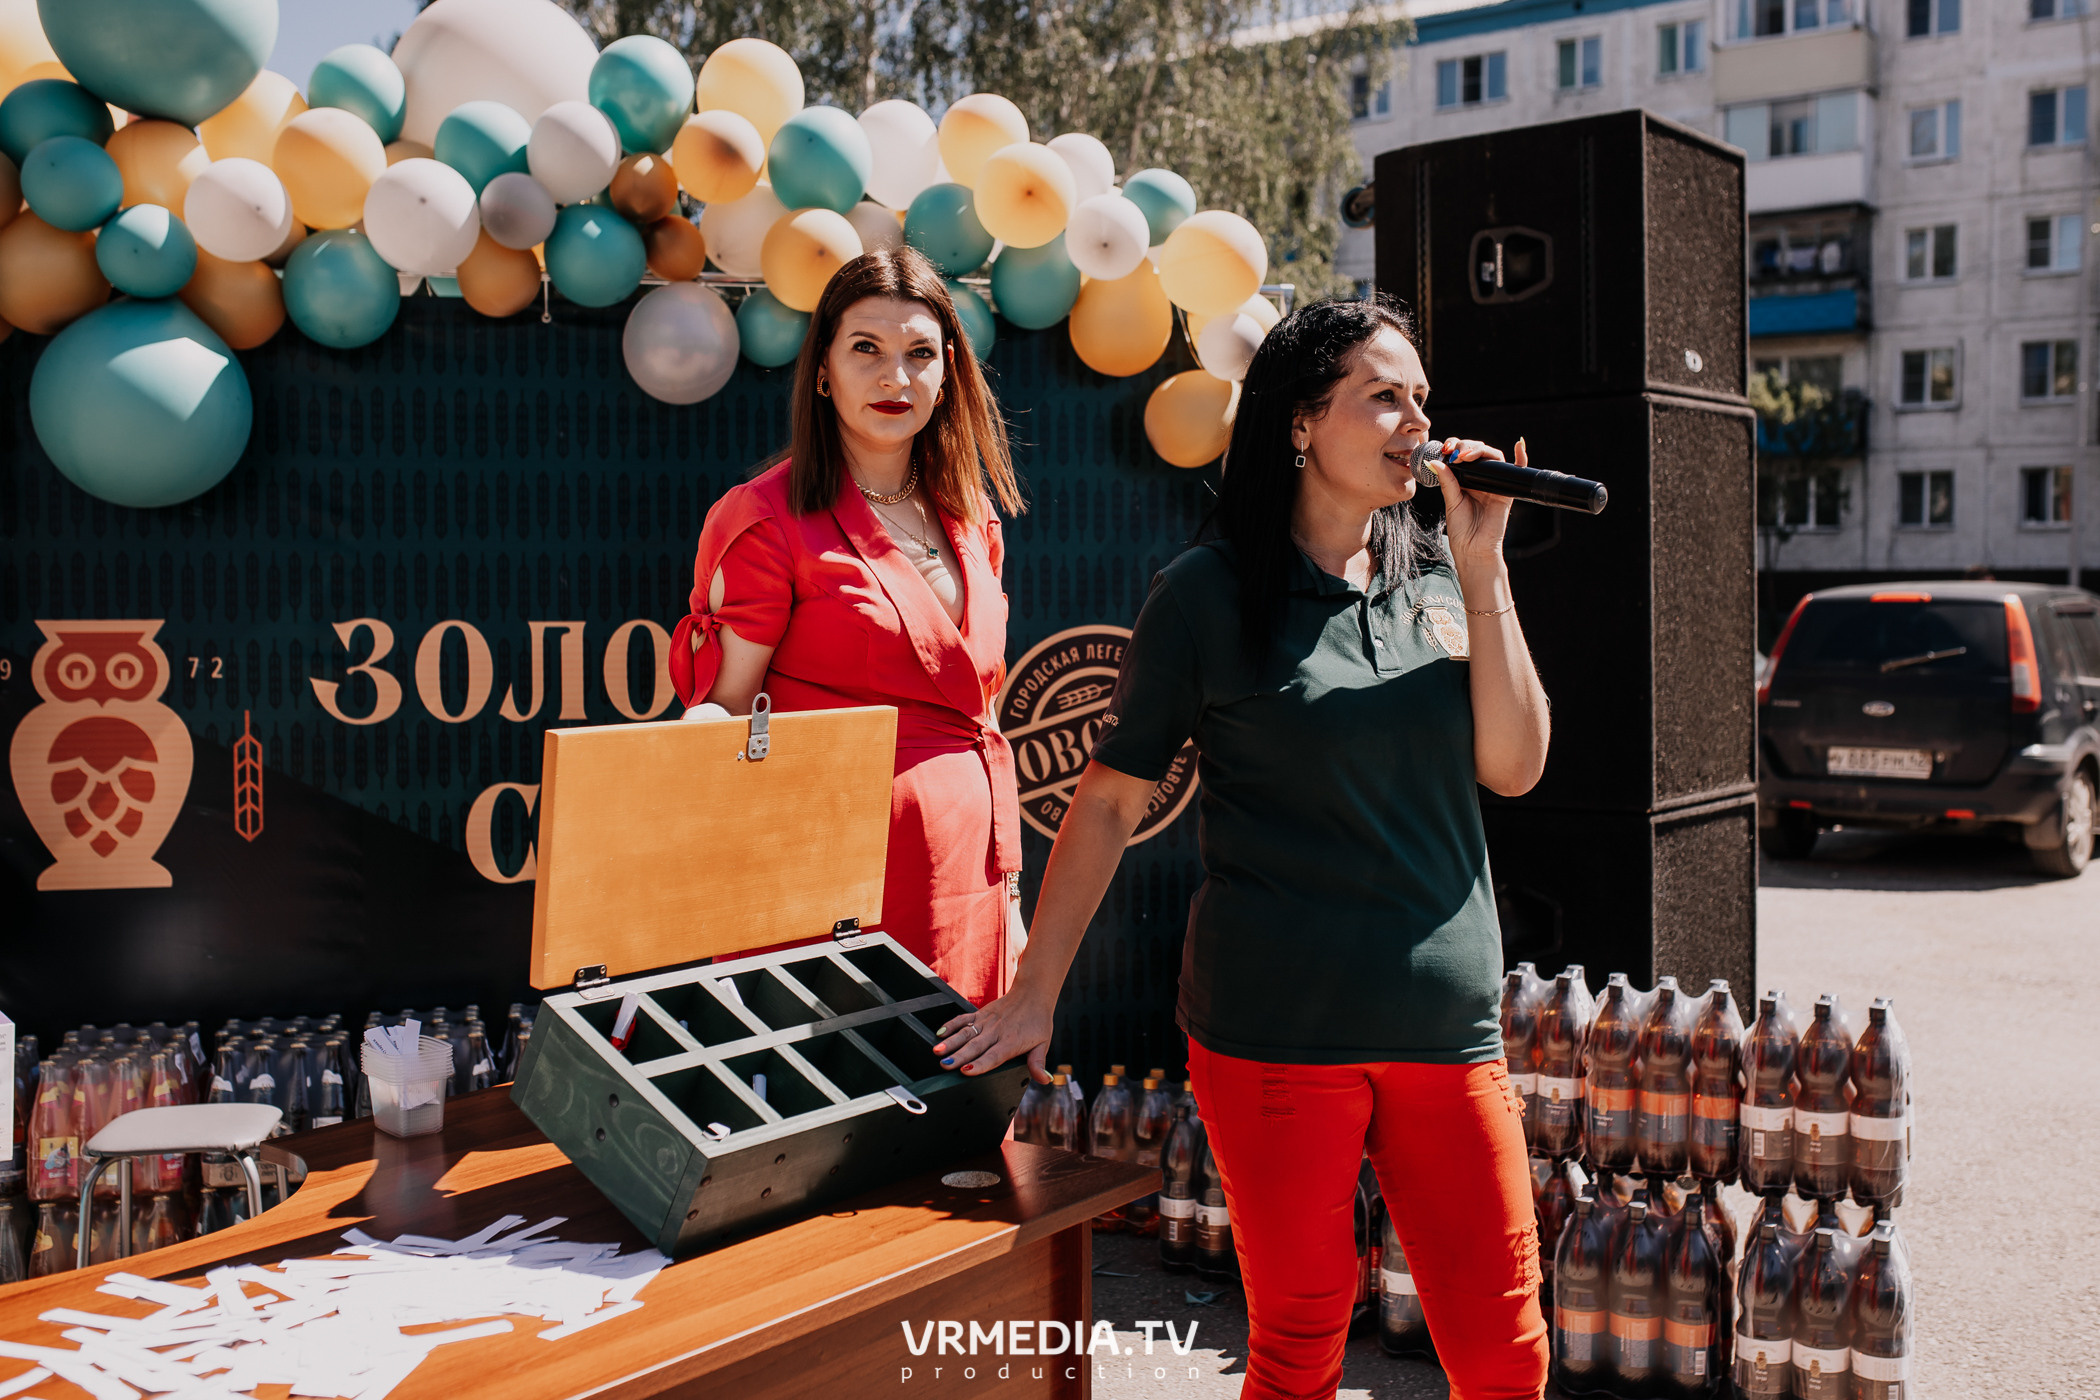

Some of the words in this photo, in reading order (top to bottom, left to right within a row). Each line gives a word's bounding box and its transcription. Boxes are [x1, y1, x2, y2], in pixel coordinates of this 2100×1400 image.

[1446, 596, 1465, 612] СОВ
[309, 618, 675, 726] ЗОЛО
[1010, 646, 1080, 719] ГОРОДСКАЯ
[1086, 643, 1123, 663] ЛЕГЕ
[465, 782, 540, 884] С
